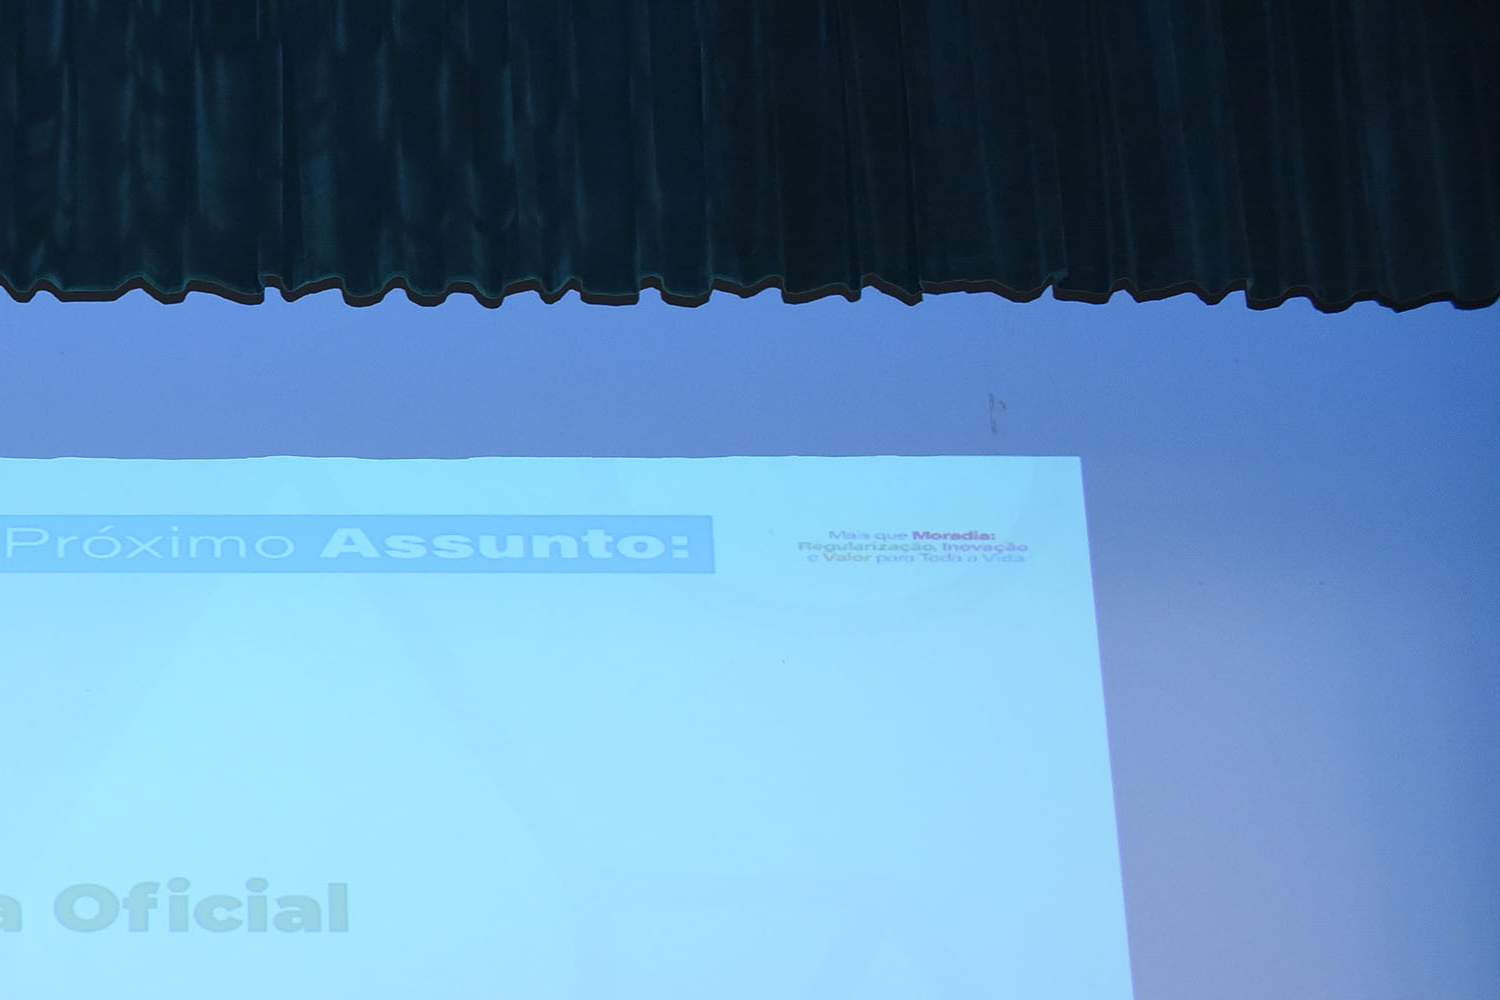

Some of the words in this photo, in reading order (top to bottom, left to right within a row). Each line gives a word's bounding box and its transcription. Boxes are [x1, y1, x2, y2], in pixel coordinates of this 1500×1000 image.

[5, 525, 295, 560] Próximo
[318, 527, 690, 560] Assunto:
[828, 530, 870, 541] Mais
[874, 532, 908, 542] que
[912, 530, 996, 541] Moradia:
[53, 877, 349, 933] Oficial
